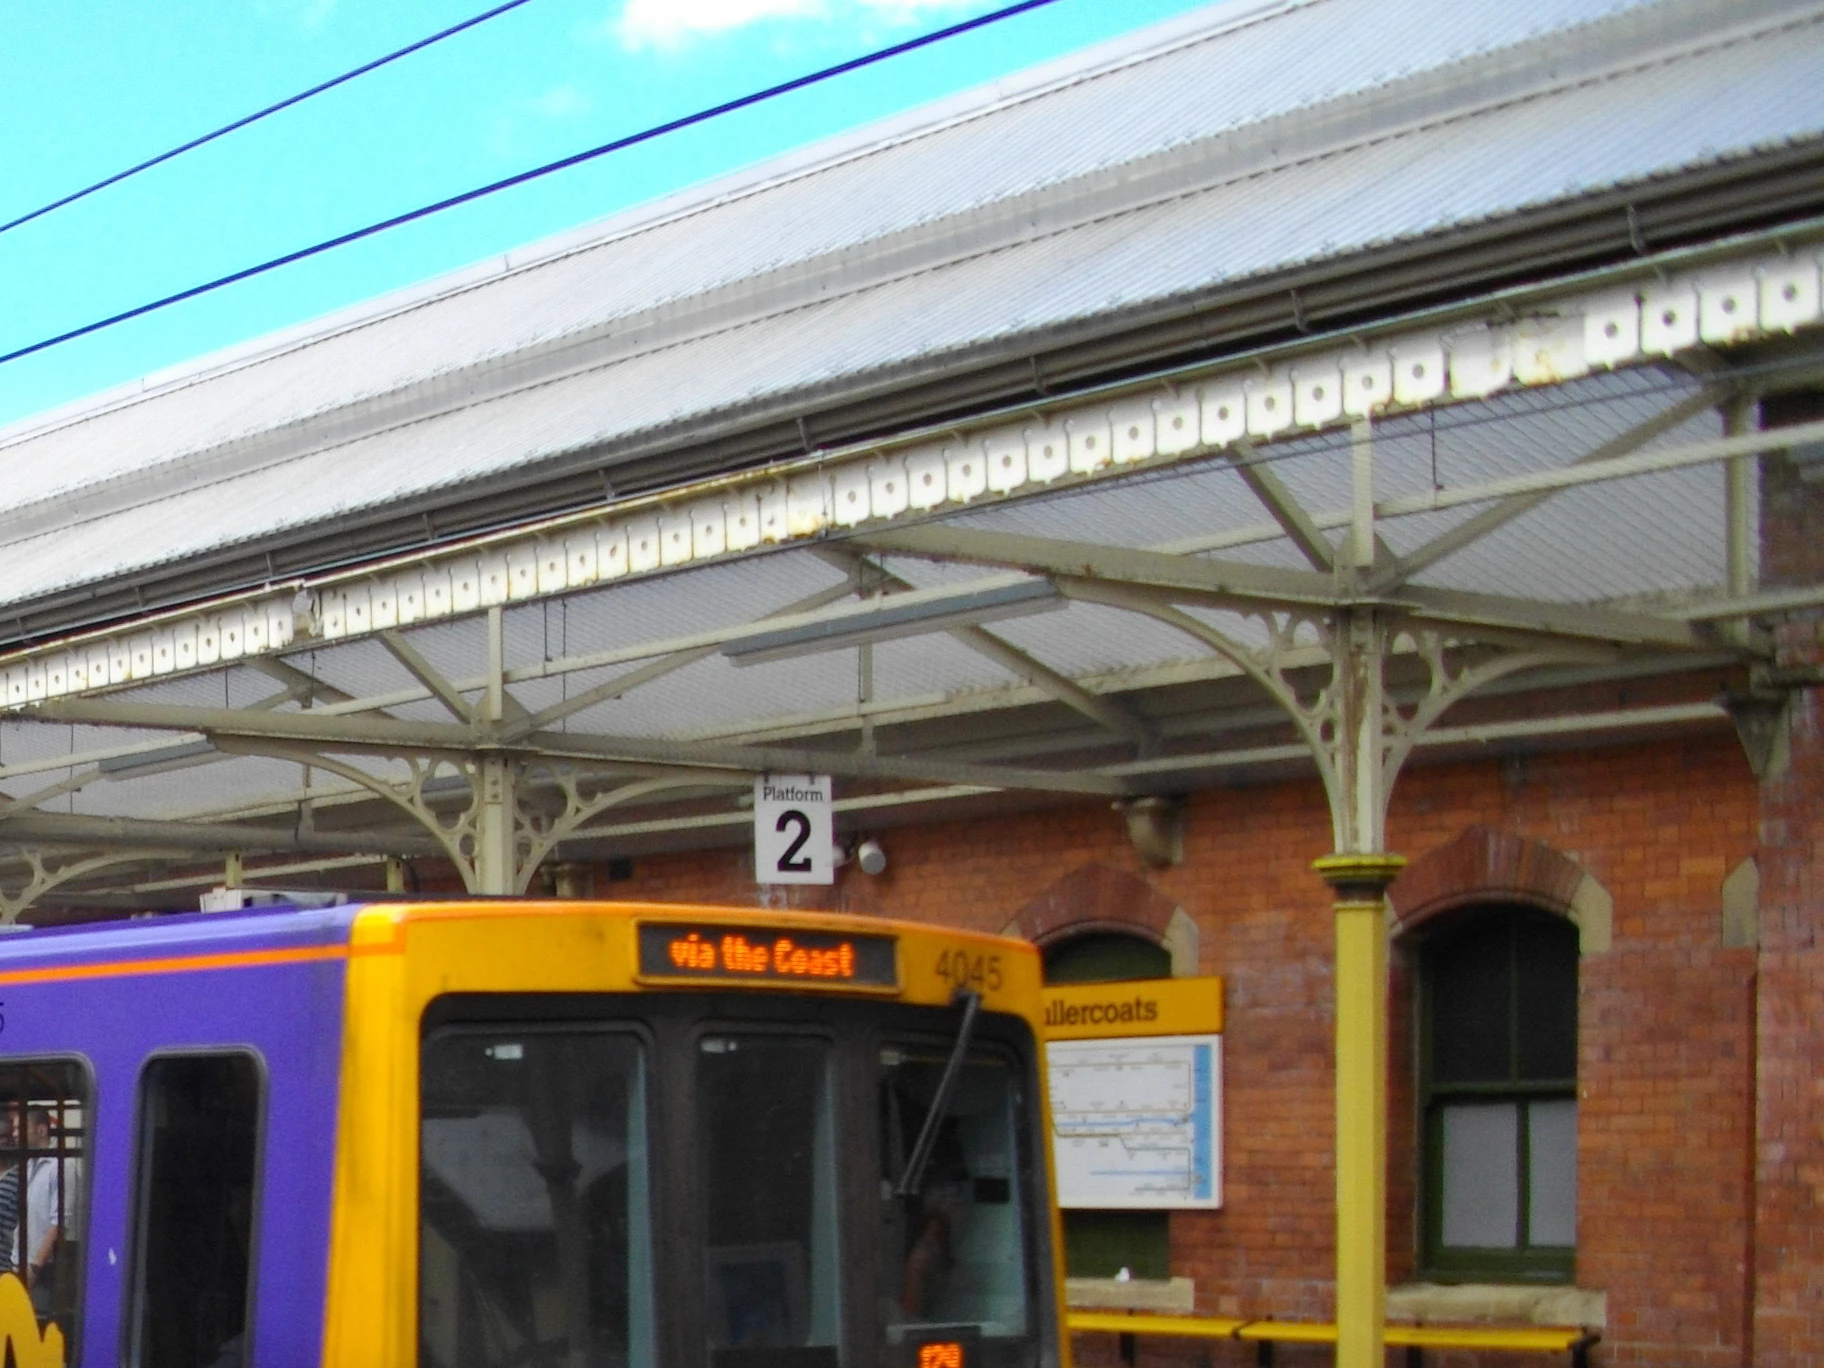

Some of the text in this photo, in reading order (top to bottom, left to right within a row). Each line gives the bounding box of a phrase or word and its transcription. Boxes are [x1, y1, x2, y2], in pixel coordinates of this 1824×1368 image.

[763, 785, 823, 802] Platform
[776, 810, 812, 872] 2
[671, 933, 854, 977] via the Coast
[934, 948, 1003, 992] 4045
